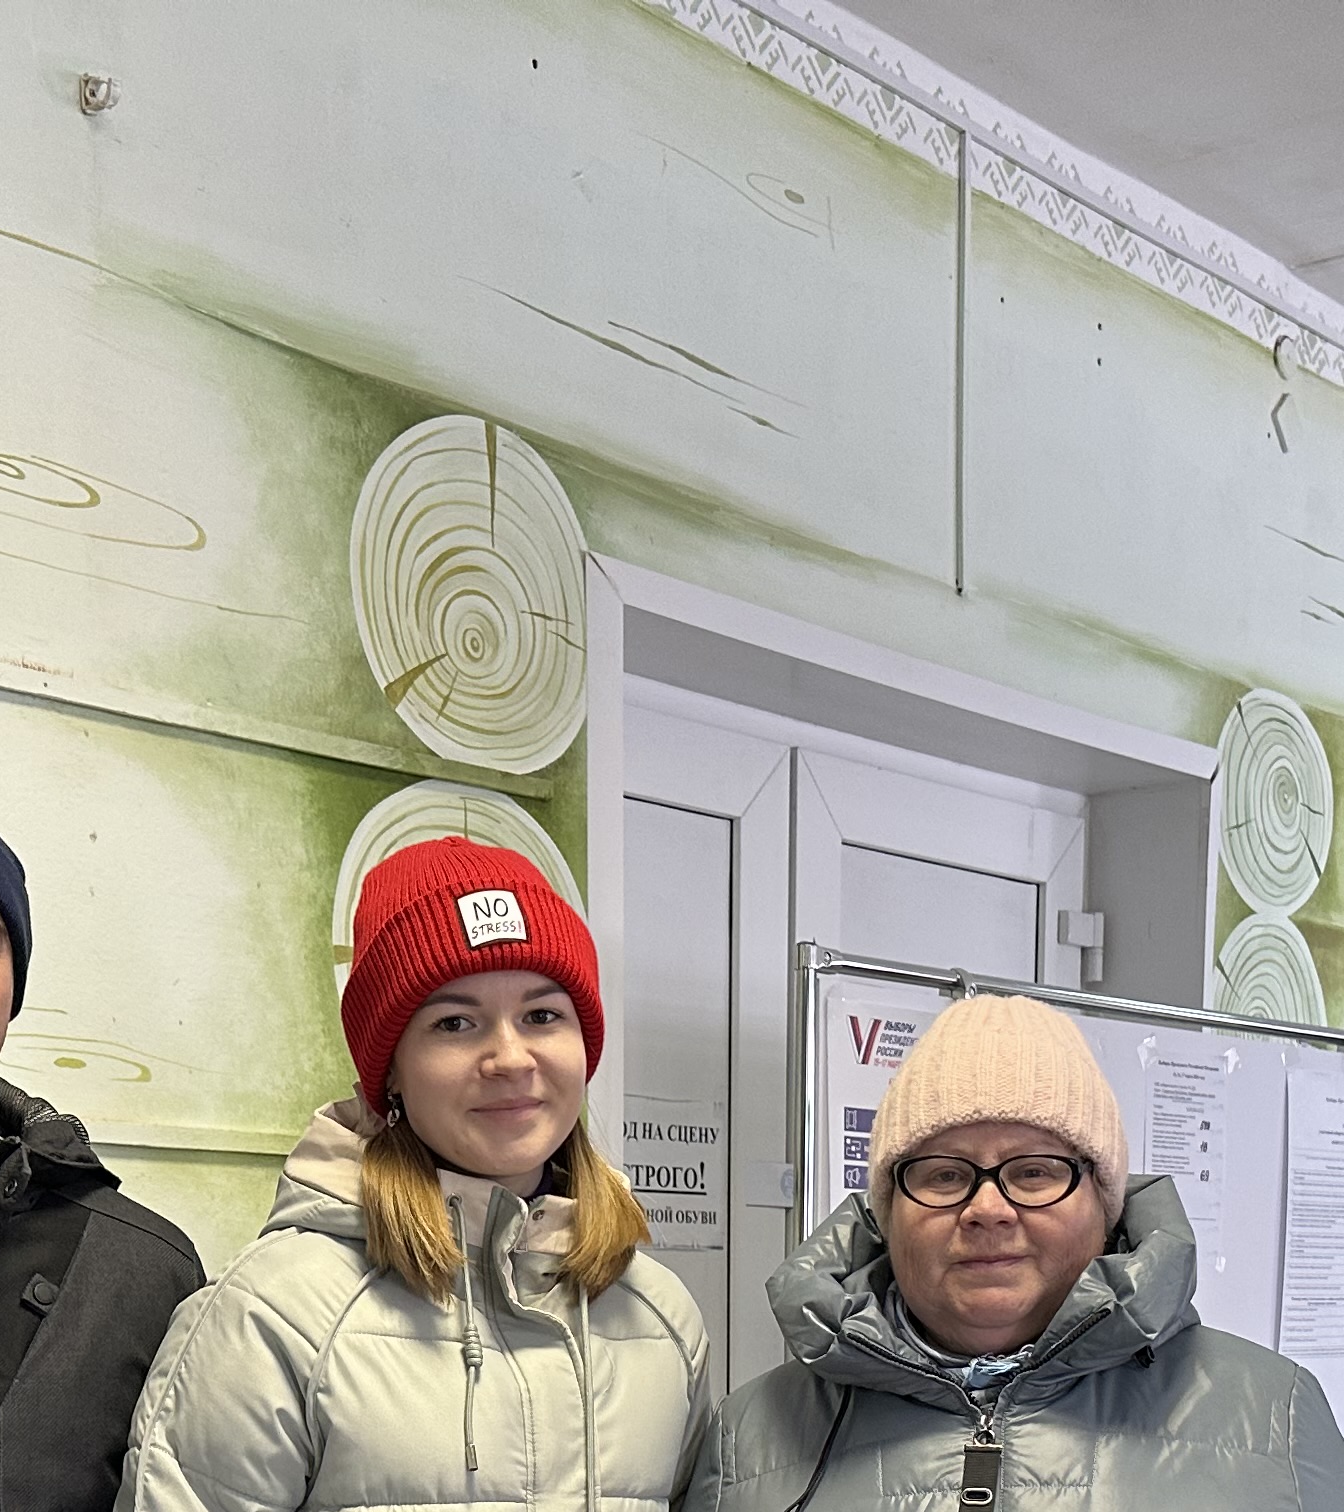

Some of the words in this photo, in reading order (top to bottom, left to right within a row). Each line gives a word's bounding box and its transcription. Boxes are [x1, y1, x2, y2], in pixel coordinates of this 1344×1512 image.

[473, 897, 508, 921] NO
[471, 920, 522, 939] STRESS!
[884, 1020, 916, 1033] ВЫБОРЫ
[876, 1046, 903, 1058] РОССИИ
[642, 1122, 663, 1140] НА
[667, 1124, 719, 1145] СЦЕНУ
[623, 1161, 705, 1190] ТРОГО!
[676, 1210, 716, 1225] ОБУВИ
